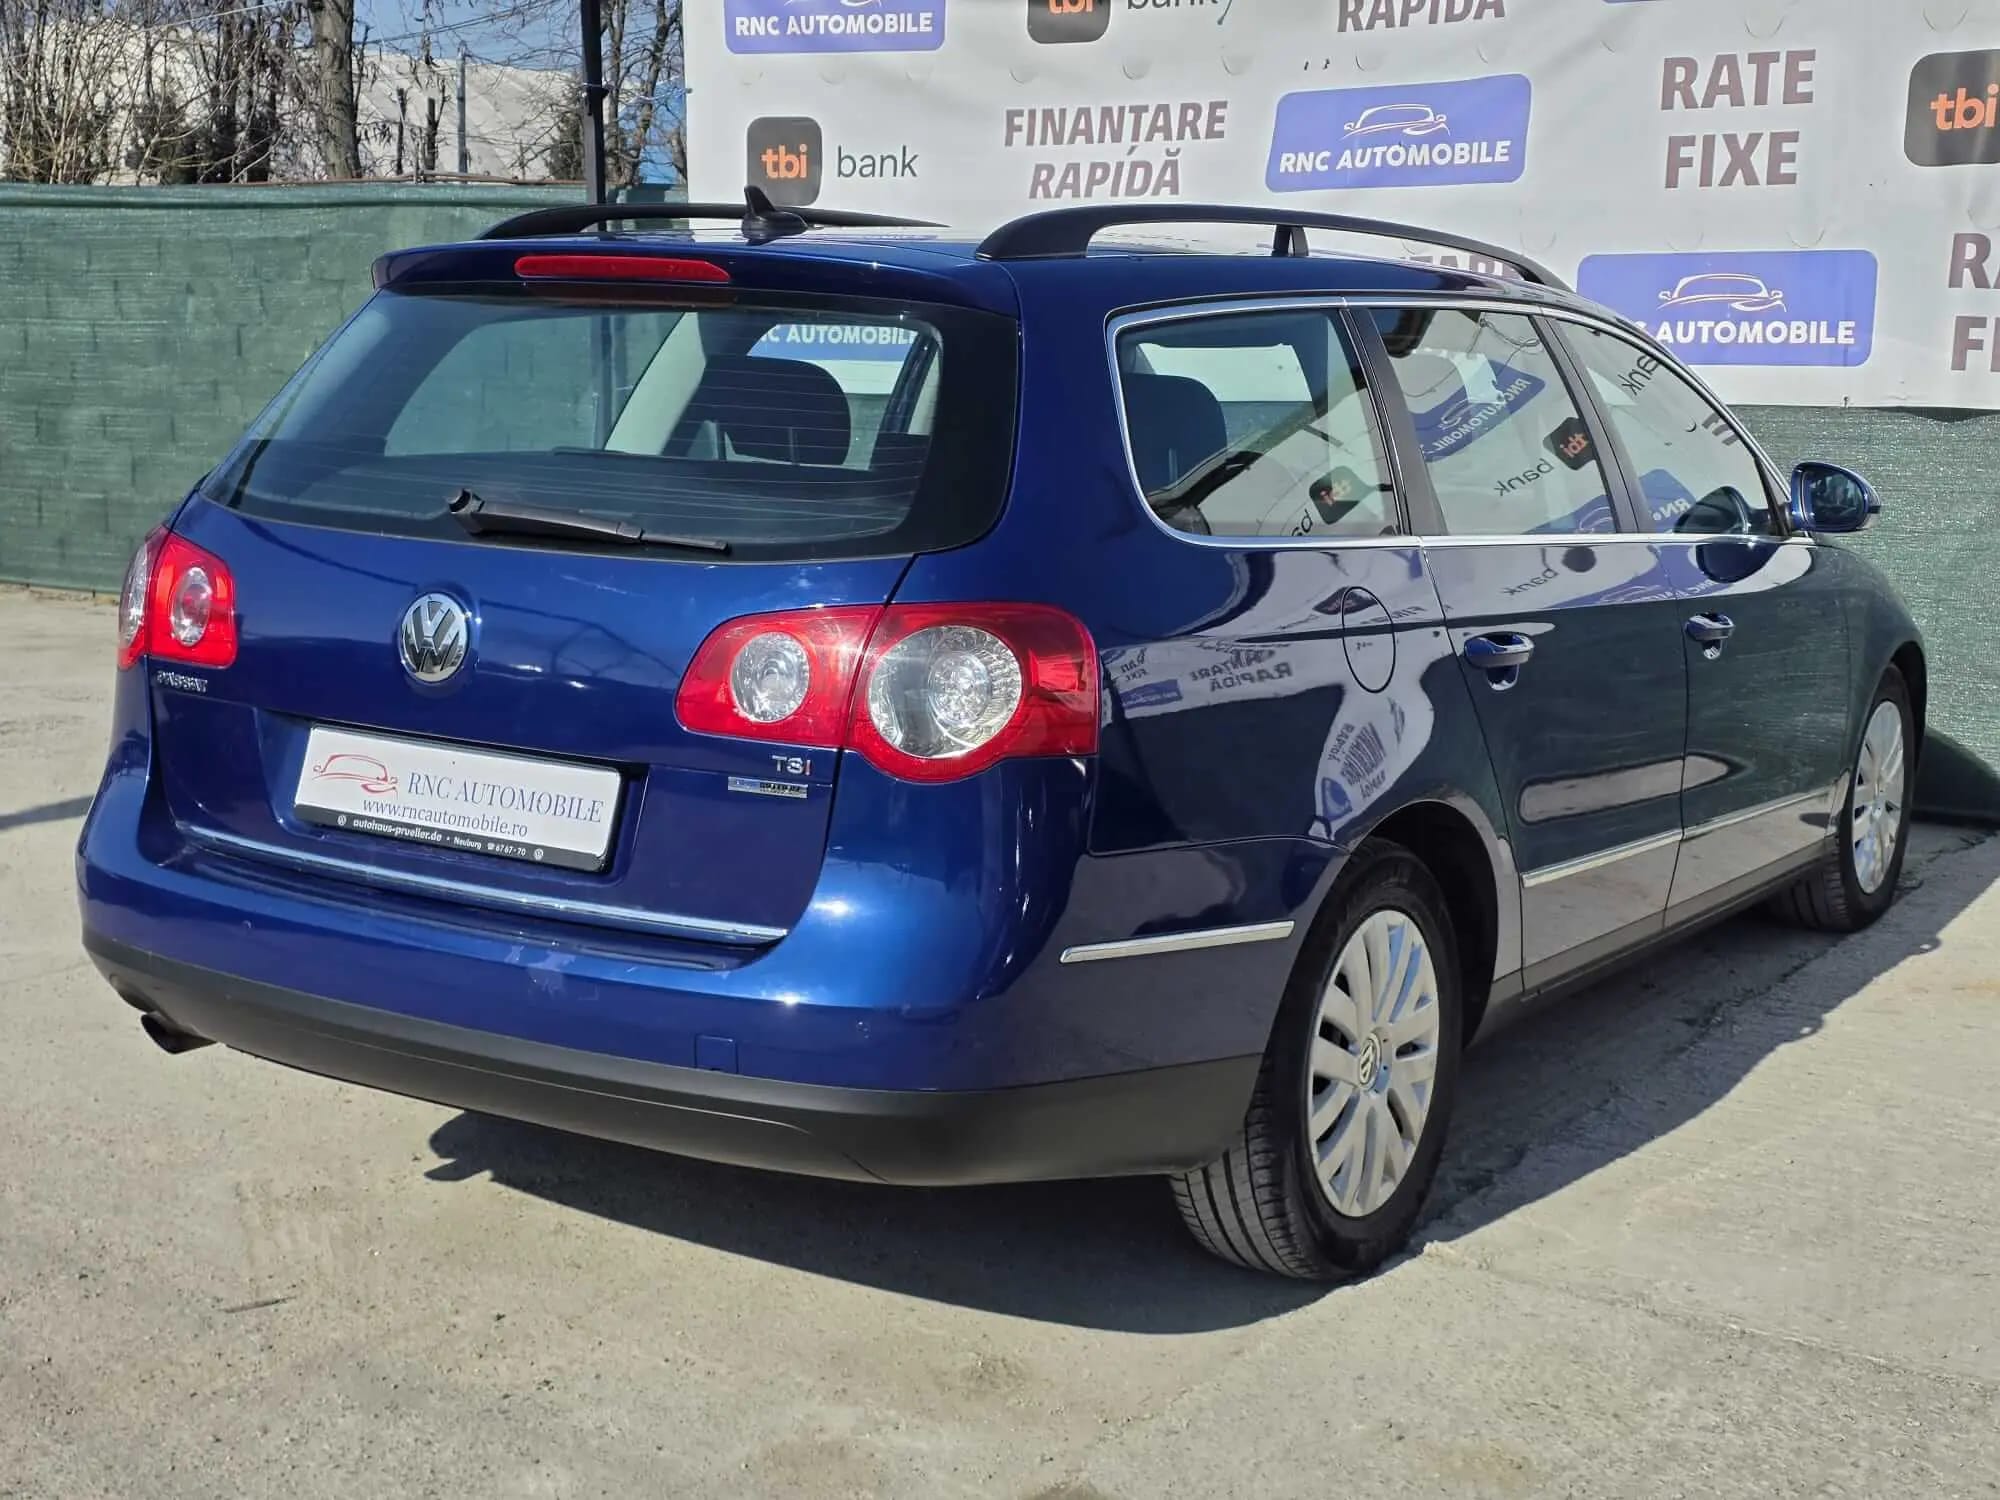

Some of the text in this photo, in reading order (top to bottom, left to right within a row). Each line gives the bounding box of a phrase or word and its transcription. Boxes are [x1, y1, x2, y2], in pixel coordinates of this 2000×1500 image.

[735, 12, 934, 36] RNC AUTOMOBILE
[1661, 49, 1816, 111] RATE
[1930, 83, 2000, 131] tbi
[761, 144, 919, 179] tbi bank
[1279, 140, 1512, 173] RNC AUTOMOBILE
[1665, 131, 1800, 189] FIXE
[1948, 232, 2000, 289] R
[1655, 320, 1856, 345] AUTOMOBILE
[363, 800, 528, 838] www.rncautomobile.ro
[407, 772, 604, 823] RNC AUTOMOBILE
